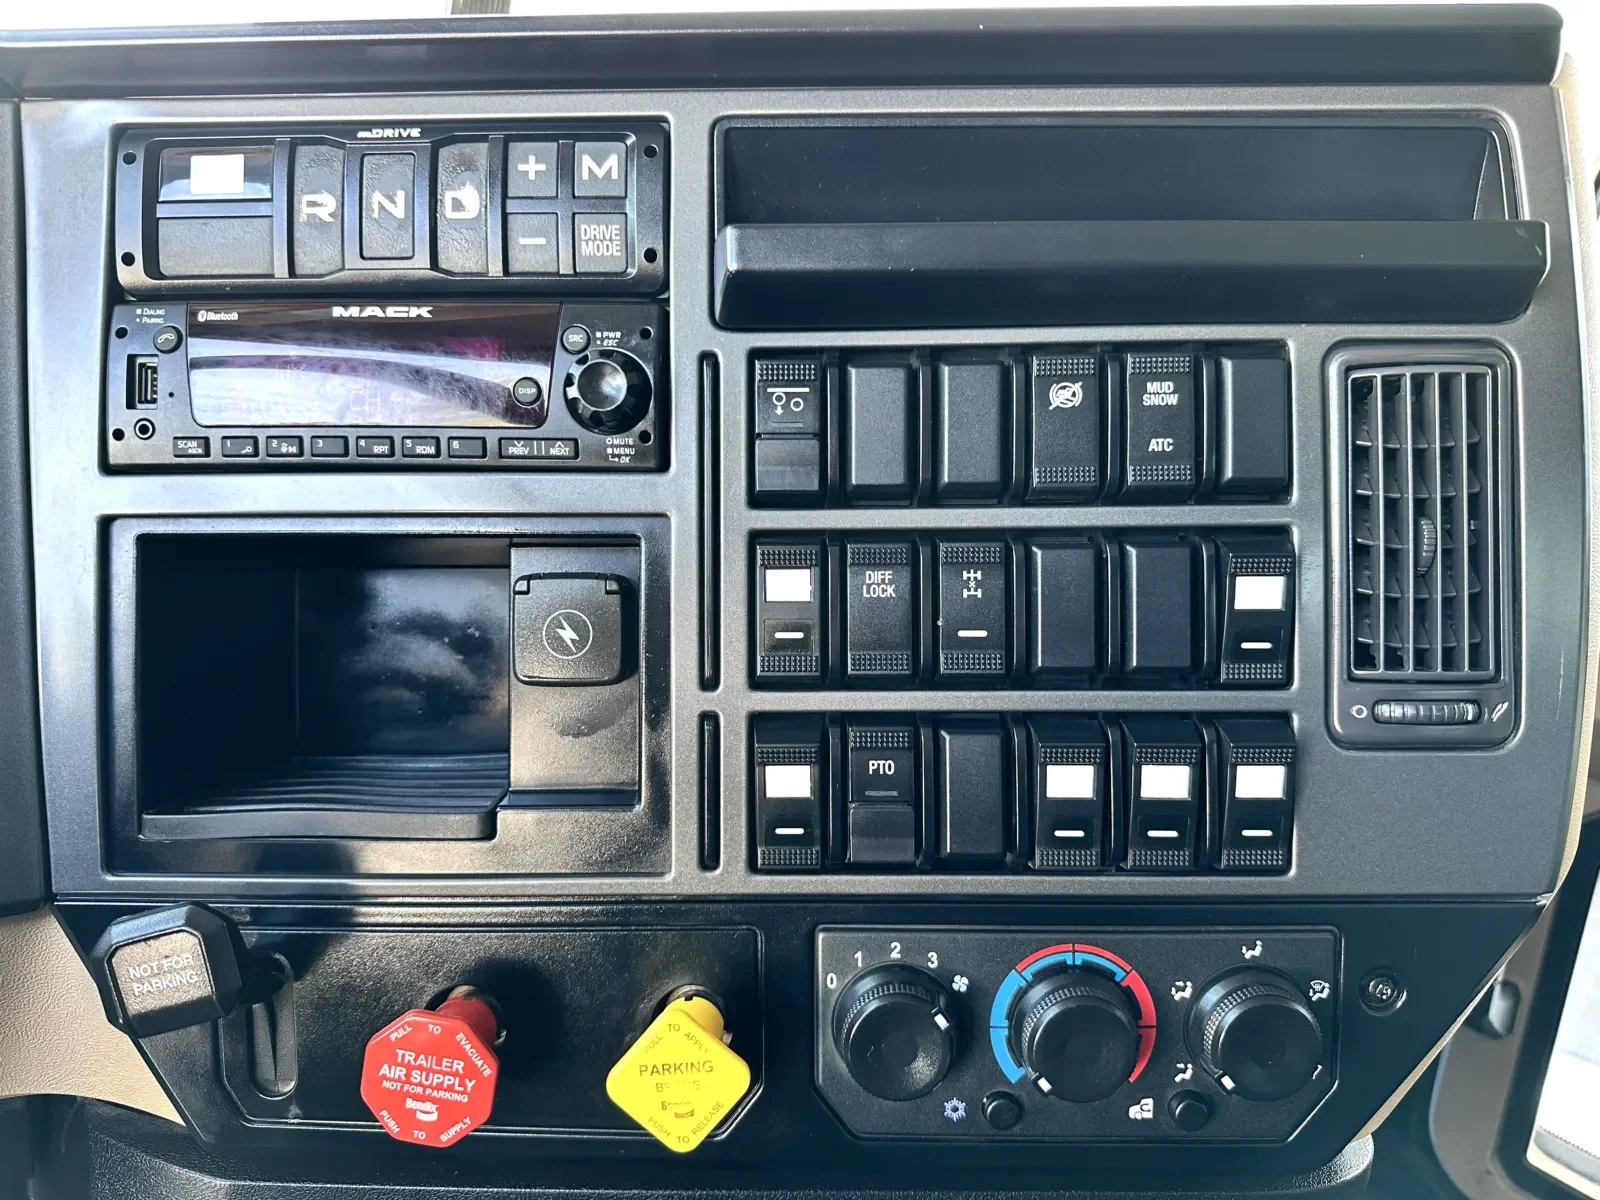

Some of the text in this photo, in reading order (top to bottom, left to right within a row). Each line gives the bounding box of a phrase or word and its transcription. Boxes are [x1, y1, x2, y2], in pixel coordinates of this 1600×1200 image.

[582, 154, 619, 181] M
[300, 192, 336, 222] R
[373, 190, 404, 219] N
[445, 184, 480, 219] D
[580, 224, 620, 240] DRIVE
[581, 241, 622, 257] MODE
[207, 311, 239, 321] Bluetooth
[332, 306, 434, 318] MACK
[568, 334, 584, 343] SRC
[602, 331, 622, 339] PWR
[602, 339, 619, 347] ESC
[518, 387, 537, 395] DISP
[1146, 381, 1174, 394] MUD
[1142, 393, 1179, 407] SNOW
[177, 440, 198, 449] SCAN
[271, 439, 278, 448] 2
[316, 439, 324, 448] 3
[359, 439, 366, 448] 4
[405, 439, 413, 448] 5
[452, 440, 460, 449] 6
[613, 437, 634, 445] MUTE
[1148, 438, 1174, 452] ATC
[373, 445, 389, 454] RPT
[415, 445, 435, 455] RDM
[508, 446, 530, 456] PREV
[549, 447, 570, 456] NEXT
[613, 447, 635, 455] MENU
[619, 456, 631, 464] OK
[865, 570, 893, 584] DIFF
[862, 584, 896, 598] LOCK
[868, 760, 895, 775] PTO
[890, 942, 901, 958] 2
[853, 951, 863, 967] 1
[927, 952, 938, 968] 3
[128, 954, 194, 979] NOT FOR
[133, 971, 198, 996] PARKING
[826, 972, 838, 989] 0
[667, 1023, 681, 1033] TO
[684, 1031, 711, 1054] APPLY
[389, 1024, 493, 1077] PULL TO EVACUATE
[395, 1048, 465, 1074] TRAILER
[638, 1060, 714, 1077] PARKING
[378, 1063, 477, 1093] AIR SUPPLY
[381, 1080, 469, 1103] NOT FOR PARKING
[405, 1097, 439, 1113] Bendix
[379, 1109, 472, 1142] PUSH TO SUPPLY
[647, 1116, 672, 1138] PUSH
[677, 1135, 690, 1145] TO
[691, 1100, 725, 1136] RELEASE
